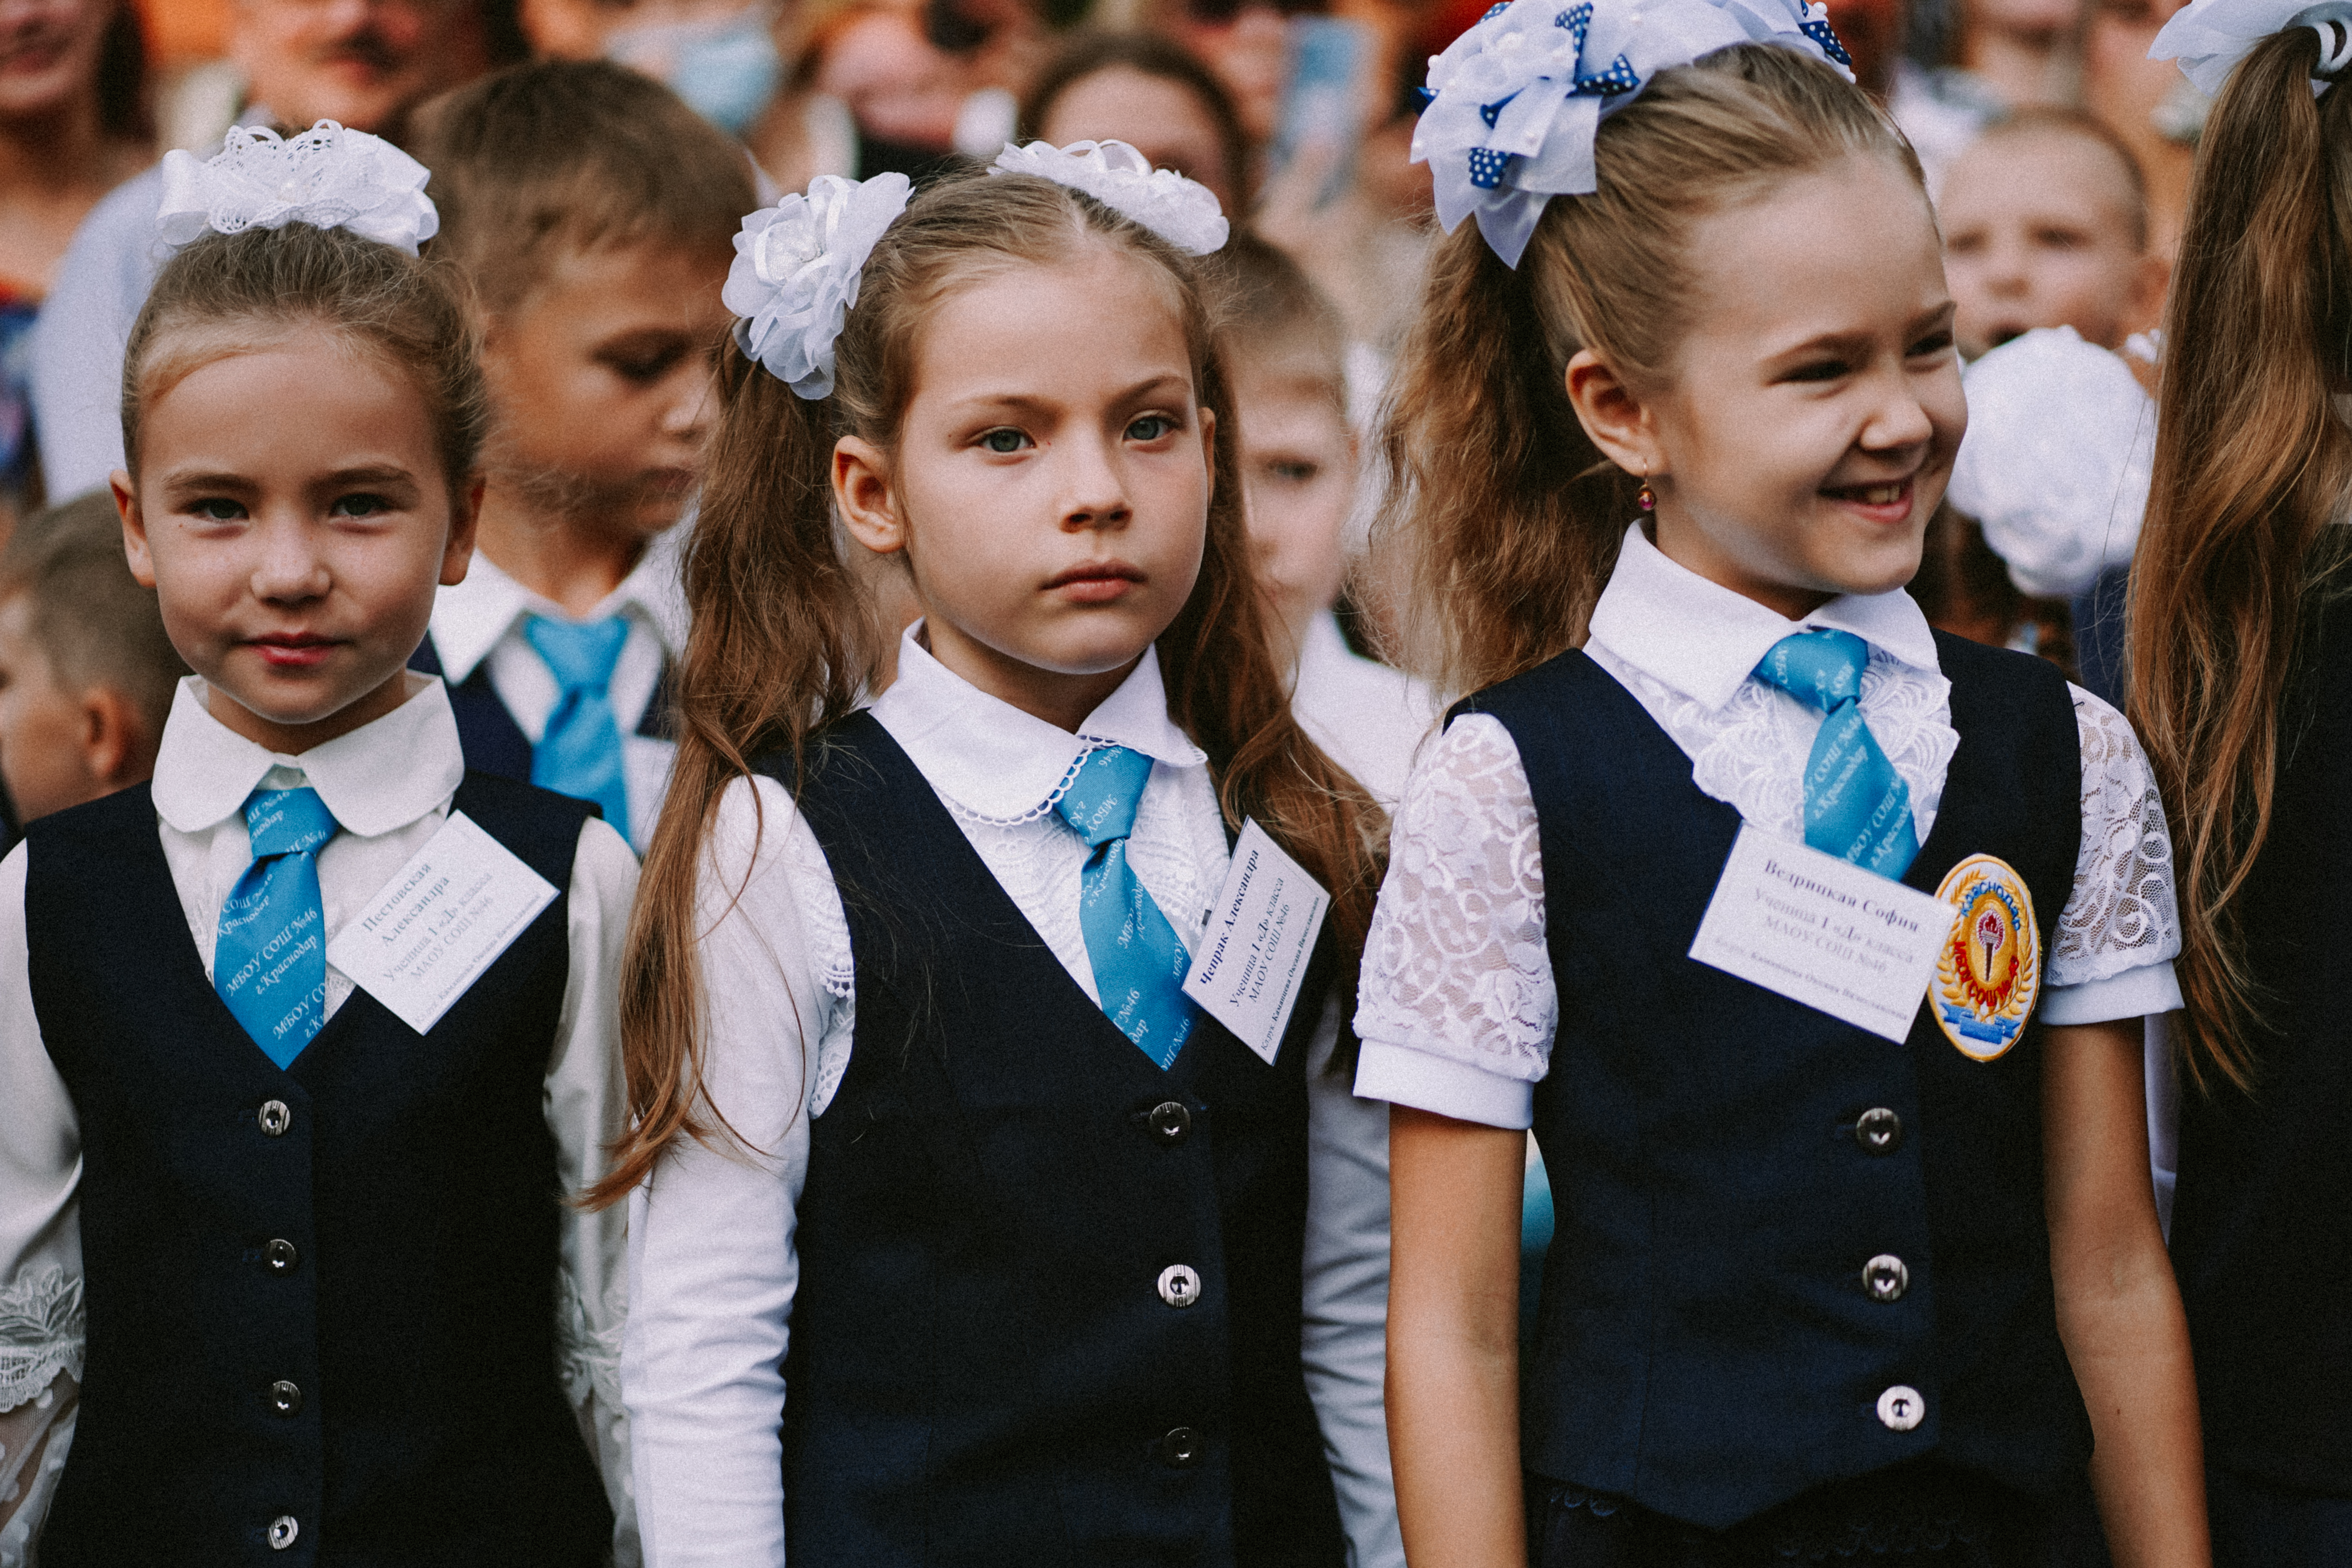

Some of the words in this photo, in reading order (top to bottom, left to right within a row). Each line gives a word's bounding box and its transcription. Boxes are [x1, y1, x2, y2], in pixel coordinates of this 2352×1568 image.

[1086, 793, 1118, 839] МБОУ
[361, 863, 432, 933] Пестовская
[381, 876, 450, 947] Александра
[1199, 932, 1229, 985] Чепрак
[1224, 849, 1259, 933] Александра
[1862, 899, 1919, 933] София
[225, 951, 261, 997] МБОУ
[262, 925, 294, 960] СОШ
[290, 906, 318, 935] №46
[1229, 953, 1257, 1007] Ученица
[1266, 877, 1284, 918] класса
[1248, 964, 1269, 1003] МАОУ
[1264, 928, 1282, 962] СОШ
[1276, 903, 1290, 931] №46
[273, 995, 310, 1040] МБОУ
[1118, 987, 1140, 1024] №46
